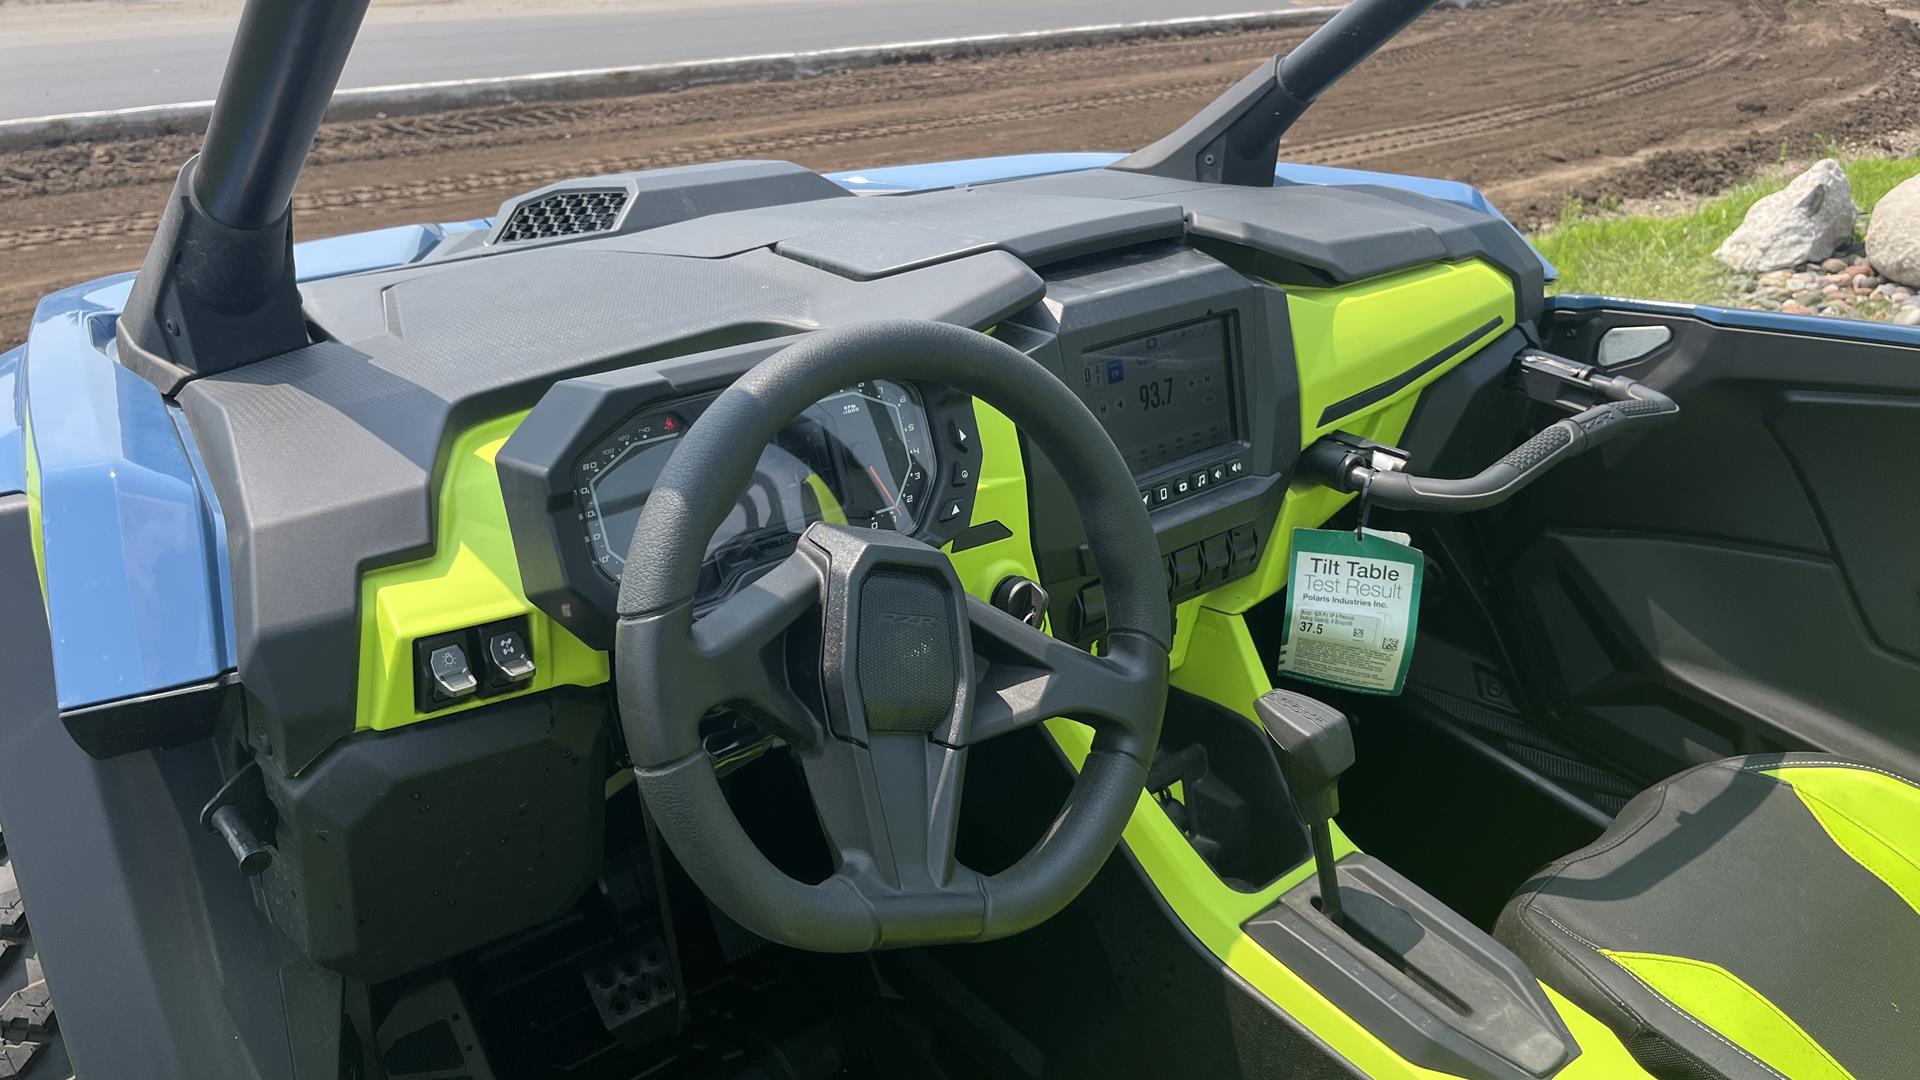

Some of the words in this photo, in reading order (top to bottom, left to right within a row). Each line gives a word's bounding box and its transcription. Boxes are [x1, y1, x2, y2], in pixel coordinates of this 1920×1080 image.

[1139, 377, 1173, 411] 93.7
[908, 423, 915, 432] 5
[913, 447, 920, 455] 4
[582, 461, 597, 471] 80
[914, 472, 920, 480] 3
[906, 495, 913, 503] 2
[871, 521, 878, 529] 0
[1310, 557, 1340, 575] Tilt
[1346, 561, 1400, 581] Table
[1304, 573, 1341, 593] Test
[1346, 578, 1403, 599] Result
[1302, 593, 1330, 603] Polaris
[1332, 596, 1371, 606] Industries
[1373, 600, 1388, 608] Inc.
[1300, 621, 1323, 635] 37.5
